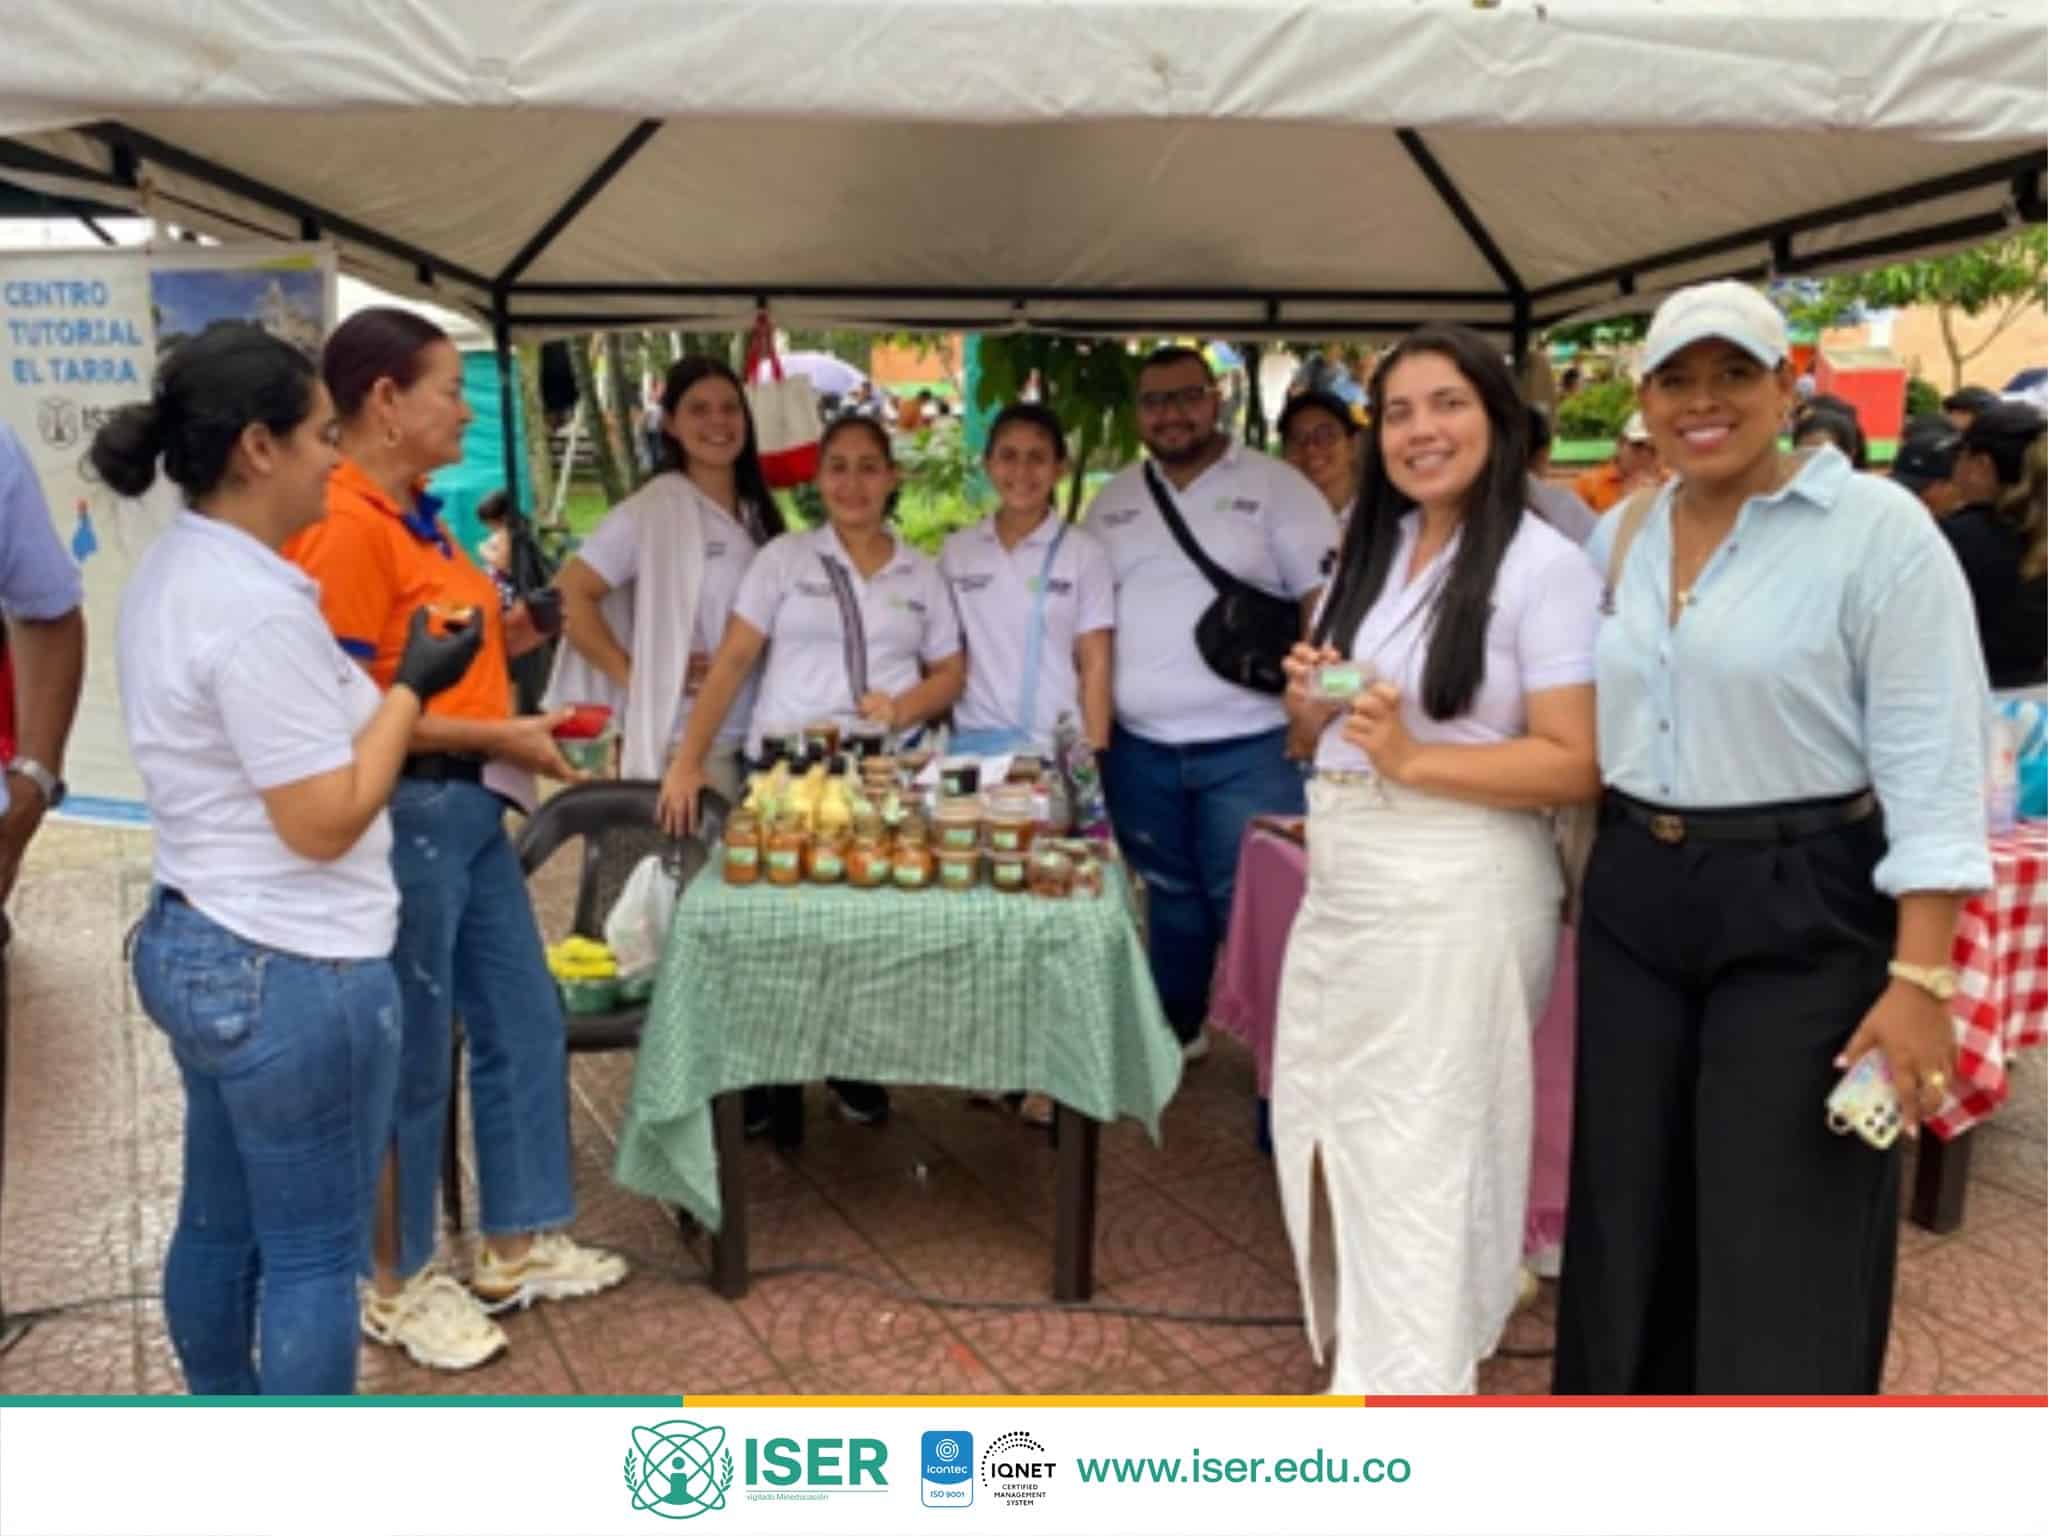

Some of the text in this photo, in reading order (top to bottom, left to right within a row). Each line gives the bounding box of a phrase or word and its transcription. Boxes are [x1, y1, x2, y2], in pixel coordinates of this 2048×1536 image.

[4, 279, 109, 307] CENTRO
[8, 319, 143, 347] TUTORIAL
[13, 358, 138, 384] EL TARRA
